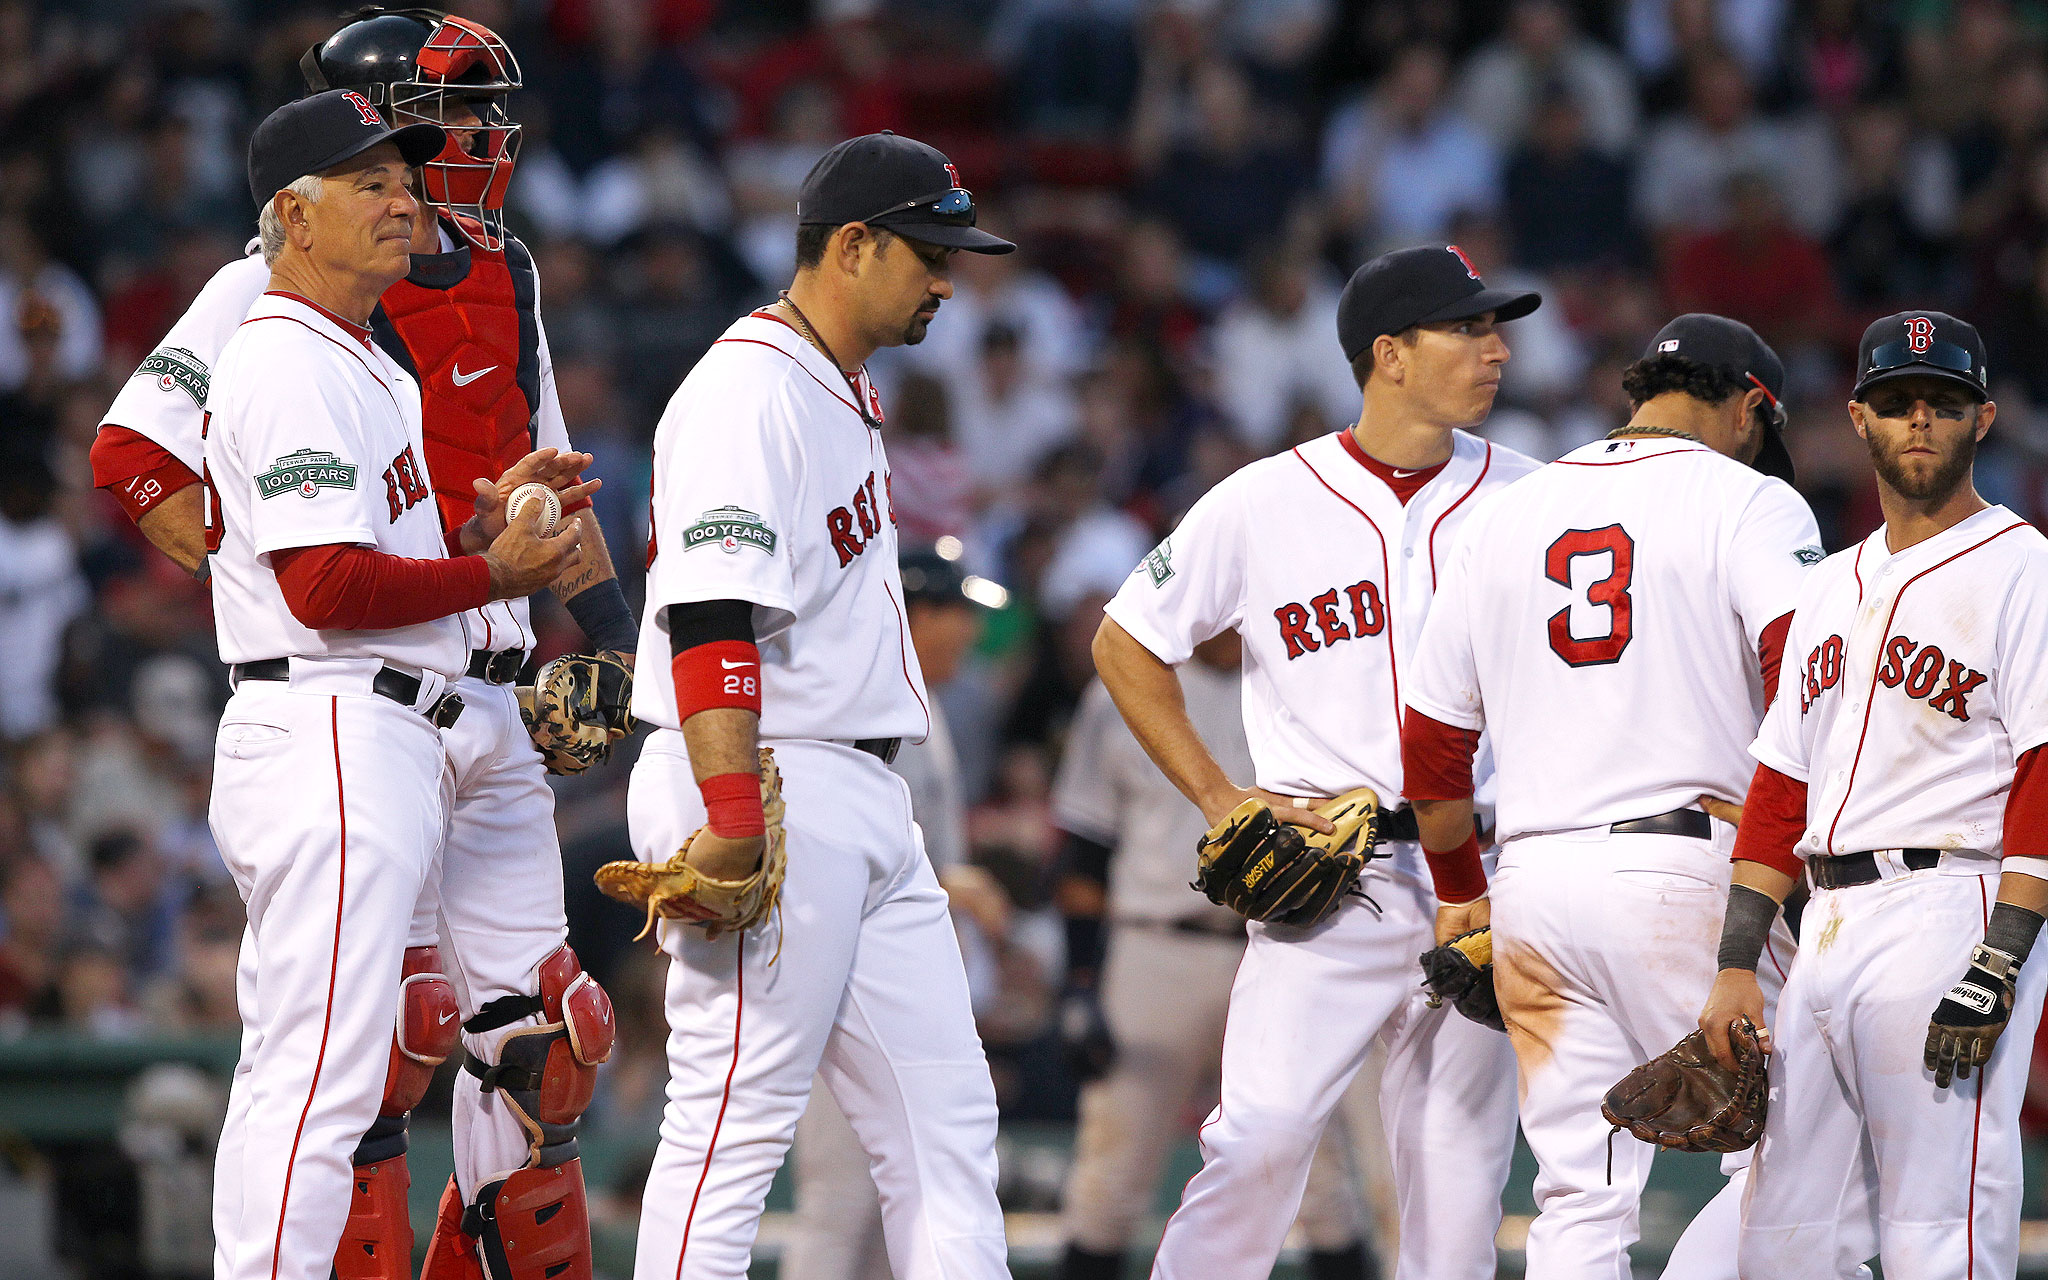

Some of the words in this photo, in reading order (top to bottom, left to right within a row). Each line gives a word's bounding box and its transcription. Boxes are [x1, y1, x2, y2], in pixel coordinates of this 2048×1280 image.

[341, 91, 381, 126] B
[1904, 316, 1936, 354] B
[166, 361, 208, 398] YEARS
[134, 478, 162, 507] 39
[264, 472, 293, 490] 100
[295, 468, 349, 482] YEARS
[689, 526, 717, 543] 100
[720, 524, 772, 546] YEARS
[1545, 522, 1635, 668] 3
[1273, 580, 1385, 661] RED
[723, 674, 756, 696] 28
[1878, 635, 1988, 722] SOX
[1241, 849, 1275, 889] ALL-STAR
